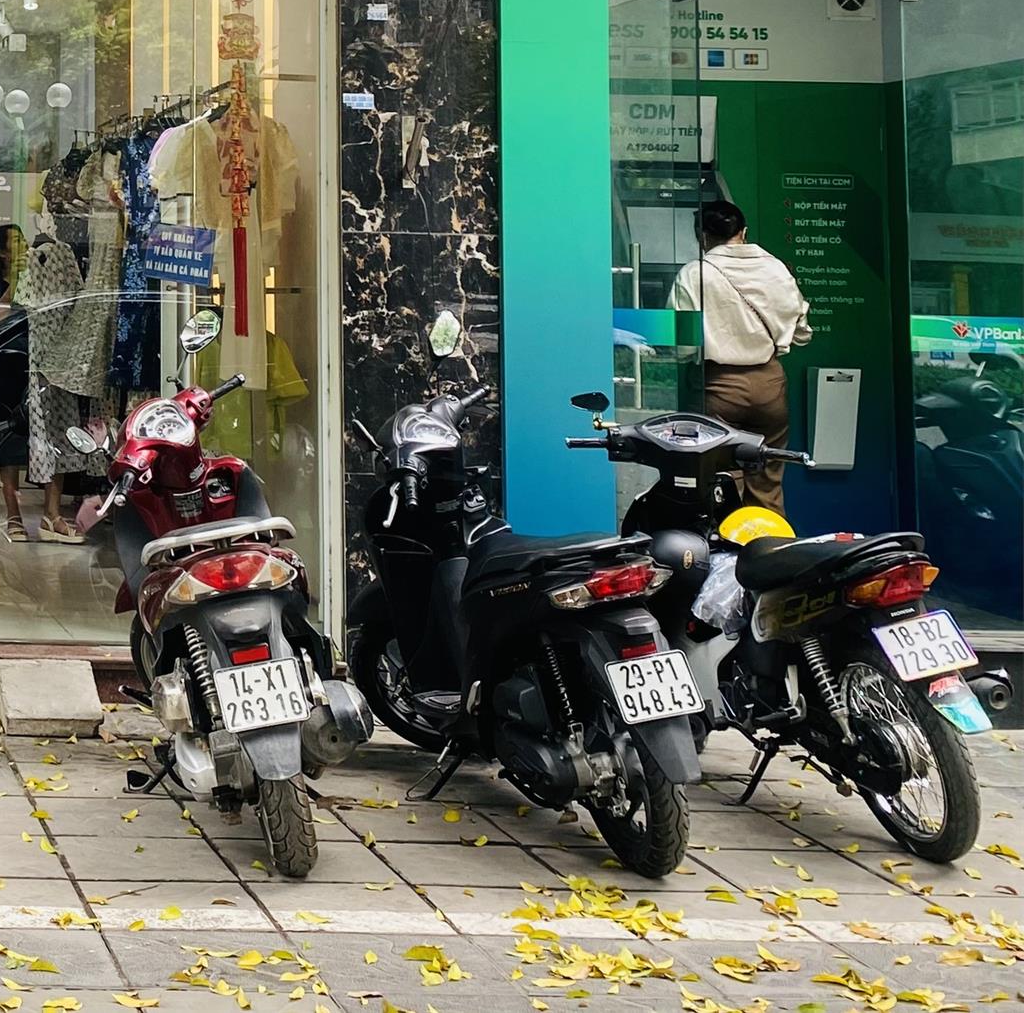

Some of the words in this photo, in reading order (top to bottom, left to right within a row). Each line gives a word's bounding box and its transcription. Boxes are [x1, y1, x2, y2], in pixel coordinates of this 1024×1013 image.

[663, 26, 702, 39] 900
[706, 27, 725, 40] 54
[729, 27, 748, 40] 54
[752, 28, 769, 41] 15
[629, 103, 675, 120] CDM
[889, 618, 949, 649] 18-B2
[893, 641, 968, 675] 729.30
[229, 664, 287, 697] 14-X1
[623, 684, 696, 717] 948.43
